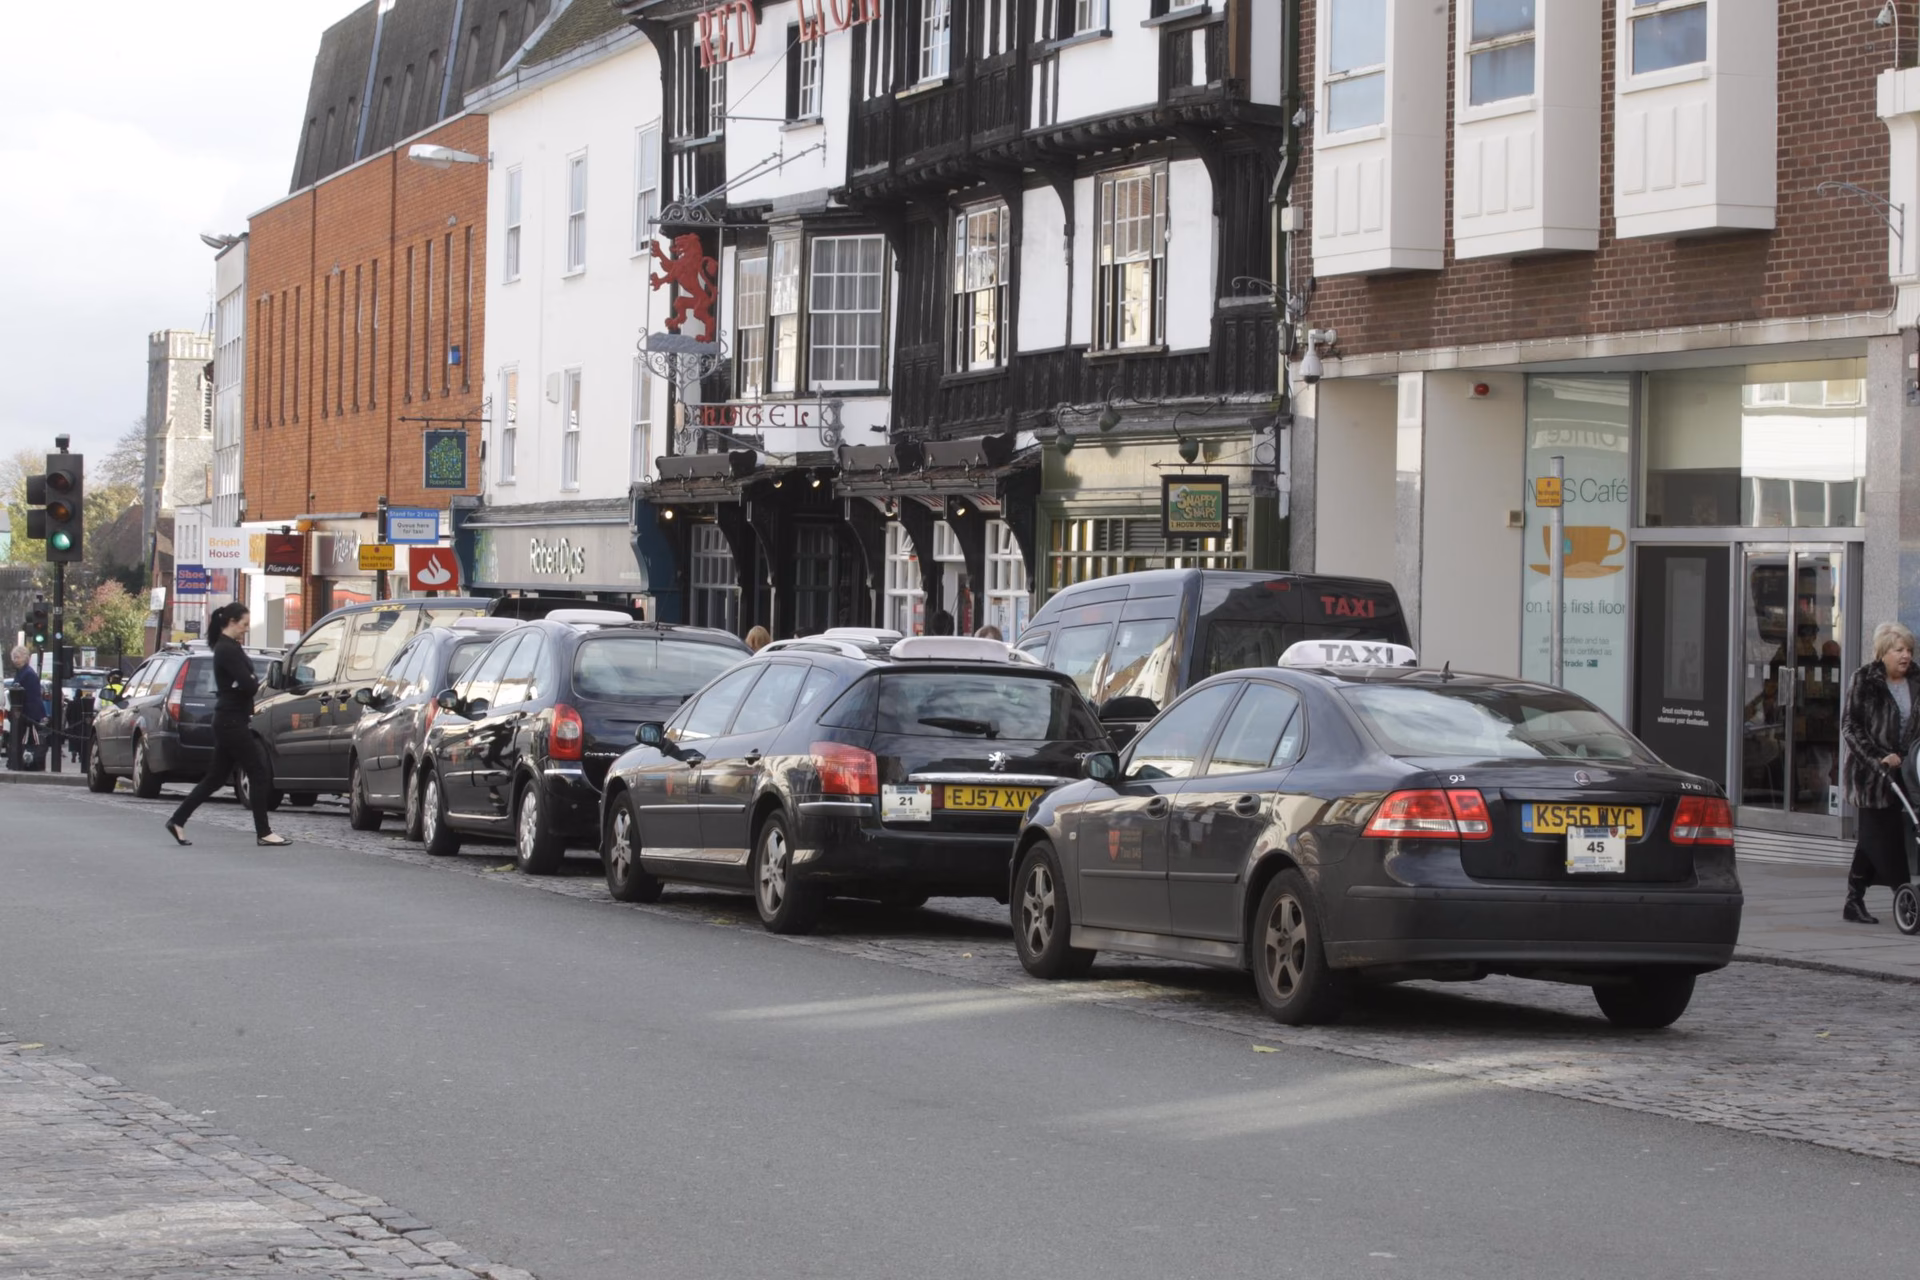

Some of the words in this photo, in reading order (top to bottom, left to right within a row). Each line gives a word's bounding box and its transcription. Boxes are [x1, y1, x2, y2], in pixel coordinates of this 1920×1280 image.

[697, 0, 756, 68] RED
[1580, 478, 1629, 503] Café
[1176, 492, 1217, 509] SNAPPY
[1182, 506, 1217, 520] SNAPS
[208, 537, 240, 548] Bright
[208, 549, 240, 558] House
[530, 538, 560, 574] Robert
[178, 569, 205, 579] Shoe
[177, 579, 206, 589] Zone
[372, 604, 407, 612] TAXI
[1320, 596, 1376, 618] TAXI
[1525, 601, 1542, 613] on
[1571, 600, 1594, 614] first
[1318, 643, 1394, 665] TAXI
[898, 796, 913, 806] 21
[952, 789, 999, 807] EJ57
[1536, 805, 1592, 827] KS56
[1586, 841, 1605, 853] 45
